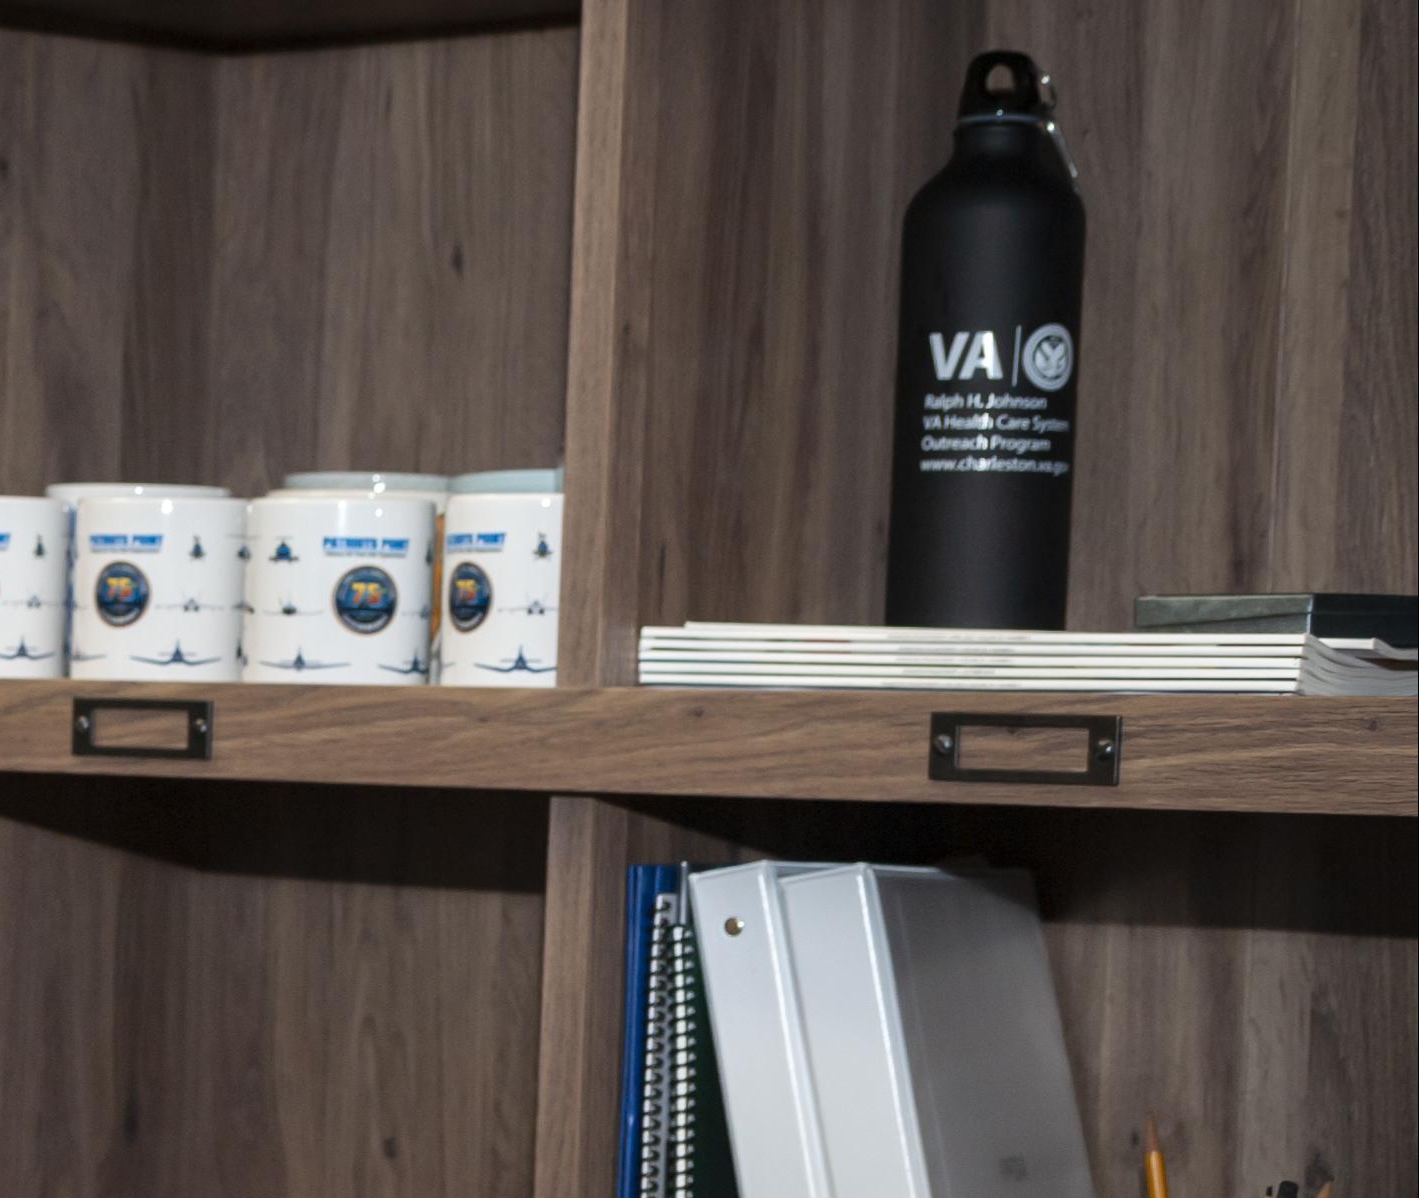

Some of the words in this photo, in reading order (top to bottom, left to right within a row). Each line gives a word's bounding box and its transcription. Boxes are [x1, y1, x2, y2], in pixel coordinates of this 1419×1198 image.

[929, 331, 1003, 381] VA
[924, 393, 964, 411] Ralph
[967, 393, 983, 409] H.
[985, 393, 1047, 410] Johnson
[923, 414, 941, 430] VA
[944, 413, 994, 430] Health
[996, 414, 1031, 431] Care
[920, 434, 988, 451] Outreach
[990, 434, 1051, 454] Program
